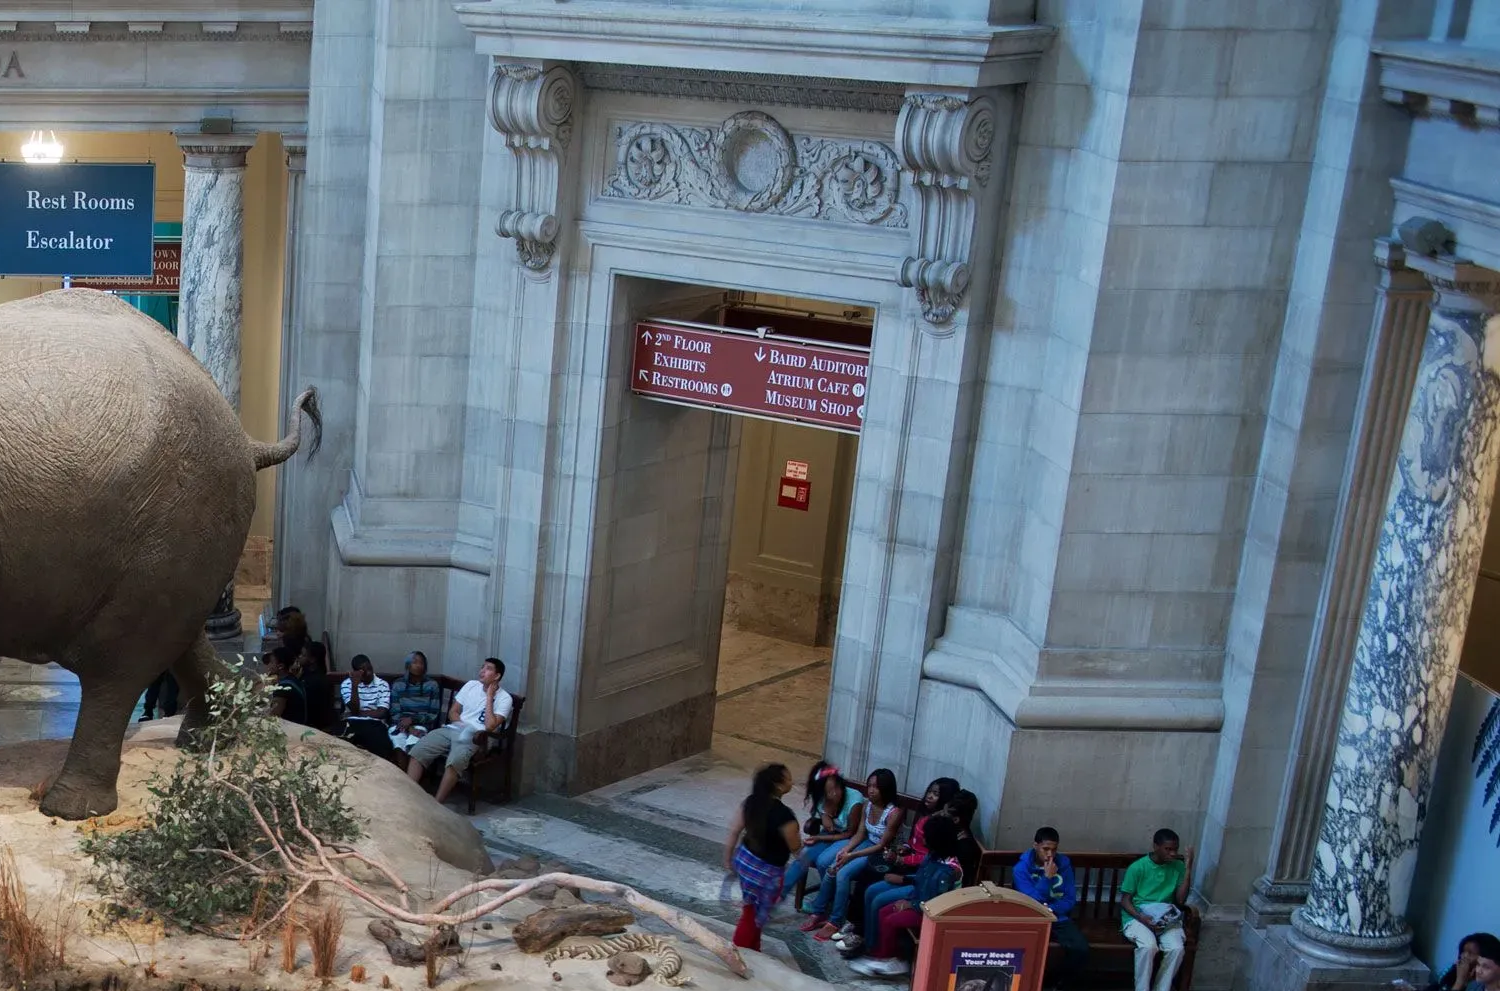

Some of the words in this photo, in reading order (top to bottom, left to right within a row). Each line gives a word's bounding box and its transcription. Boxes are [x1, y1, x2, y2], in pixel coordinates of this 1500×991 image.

[26, 190, 67, 209] Rest
[72, 191, 135, 210] Rooms
[26, 230, 113, 250] Escalator
[154, 249, 178, 258] OWN
[153, 261, 179, 270] LOOR
[673, 335, 712, 354] FLOOR
[653, 351, 706, 373] EXHIBITS
[769, 349, 807, 368] BAIRD
[651, 371, 718, 395] RESTROOMS
[767, 370, 814, 390] ATRIUM
[817, 378, 850, 396] CAFE
[764, 390, 817, 412] MUSEUM
[820, 399, 854, 417] SHOP
